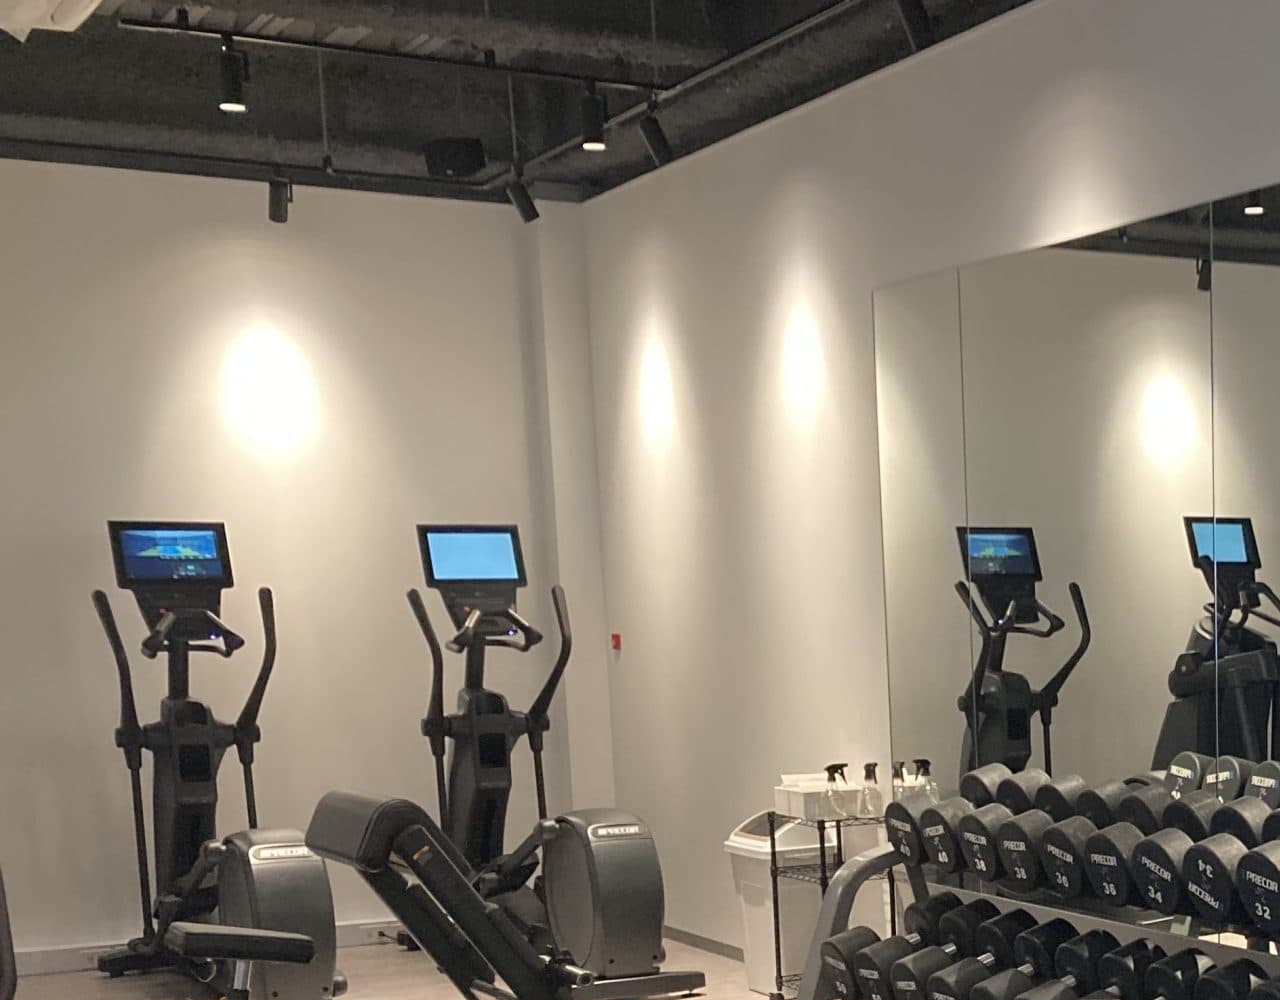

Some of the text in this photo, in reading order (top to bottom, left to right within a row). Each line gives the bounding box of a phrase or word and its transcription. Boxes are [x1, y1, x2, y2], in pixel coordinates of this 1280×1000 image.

[938, 851, 949, 863] 40
[1047, 844, 1074, 864] PRECOR
[1090, 853, 1117, 867] PRECOR
[975, 858, 987, 872] 38
[1014, 867, 1027, 880] 38
[1141, 856, 1172, 882] PRECOR
[1198, 859, 1214, 878] 34
[1055, 872, 1069, 888] 36
[1246, 871, 1278, 893] PRECOR
[1102, 882, 1117, 896] 36
[1148, 886, 1163, 903] 34
[1188, 881, 1220, 910] PRECOR
[1255, 903, 1271, 920] 32
